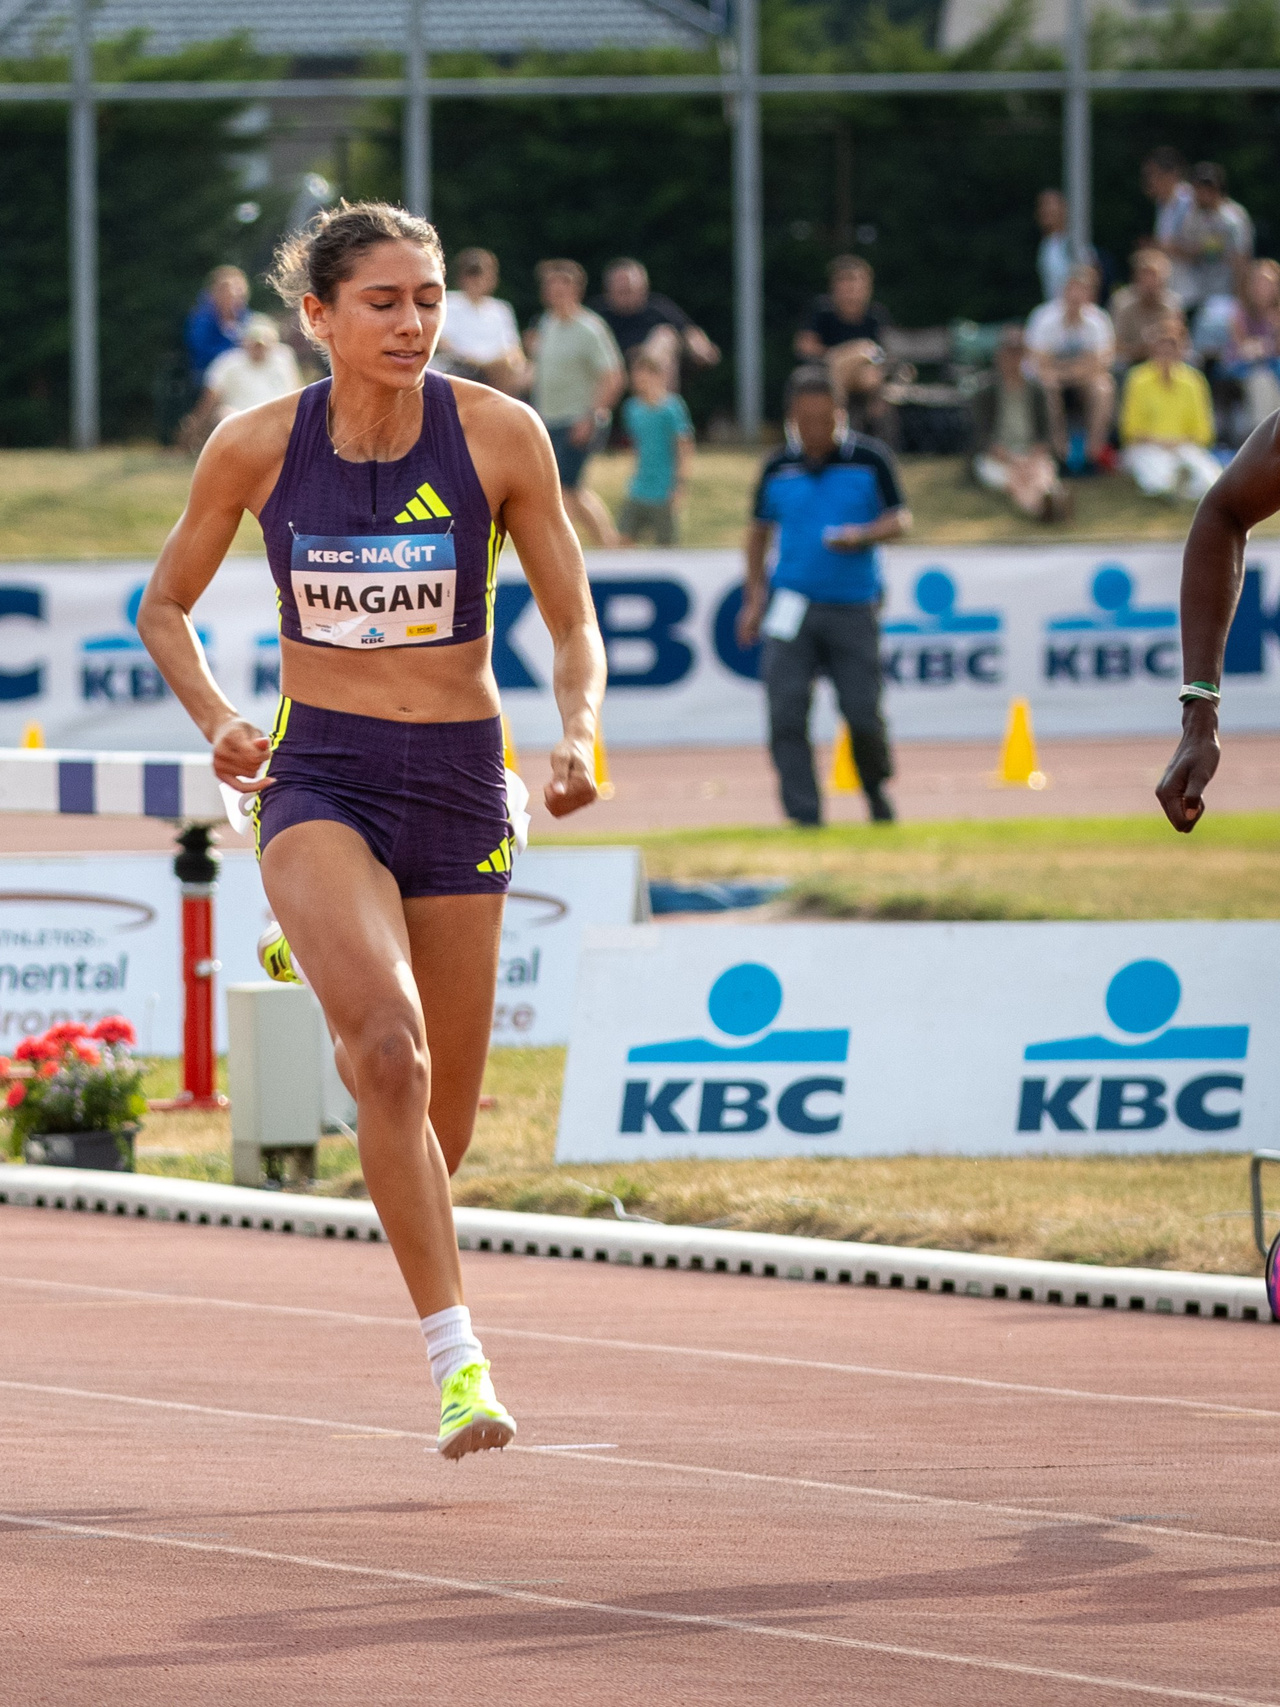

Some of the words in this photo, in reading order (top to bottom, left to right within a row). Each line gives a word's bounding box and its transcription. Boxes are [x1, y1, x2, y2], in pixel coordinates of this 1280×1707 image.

[303, 582, 443, 614] HAGAN
[360, 636, 385, 645] KBC
[1046, 642, 1180, 681] KBC
[82, 665, 167, 701] KB
[620, 1076, 845, 1136] KBC
[1017, 1072, 1245, 1133] KBC
